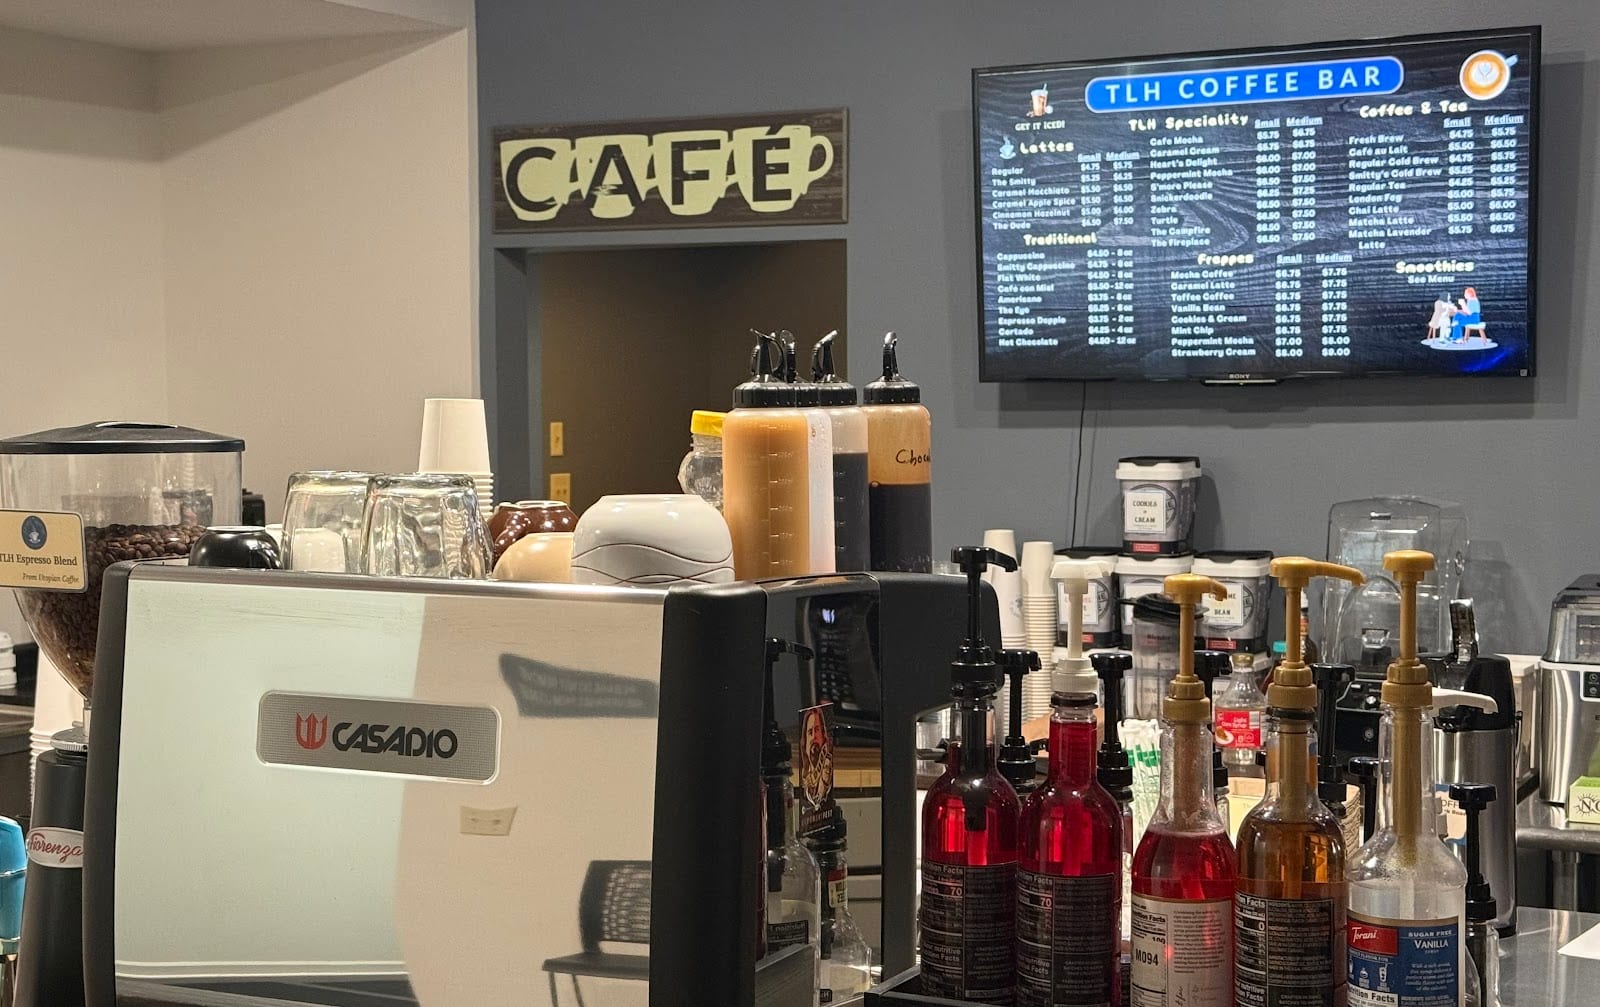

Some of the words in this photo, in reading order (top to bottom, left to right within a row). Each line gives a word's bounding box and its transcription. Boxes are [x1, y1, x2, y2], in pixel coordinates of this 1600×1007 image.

[1106, 82, 1161, 103] TLH
[1179, 73, 1298, 98] COFFEE
[1318, 67, 1379, 89] BAR
[1359, 102, 1412, 118] Coffee
[1421, 101, 1431, 114] &
[1439, 98, 1468, 113] Tea
[1129, 118, 1155, 131] TLH
[1165, 112, 1248, 131] Speciality
[1255, 118, 1279, 128] Small
[1286, 115, 1322, 126] Medium
[1443, 116, 1471, 127] Small
[1484, 113, 1523, 125] Medium
[1014, 123, 1030, 131] GET
[1033, 122, 1041, 130] IT
[1043, 121, 1065, 129] ICED!
[1150, 137, 1171, 145] Cafe
[1174, 135, 1203, 144] Mocha
[1349, 135, 1375, 144] Fresh
[1378, 133, 1403, 142] Brew
[1020, 140, 1073, 153] Lattes
[1150, 147, 1186, 157] Caramel
[1189, 146, 1219, 155] Cream
[1349, 147, 1371, 156] Café
[1389, 145, 1407, 154] Lait
[1077, 153, 1101, 163] Small
[1106, 150, 1139, 161] Medium
[1349, 158, 1385, 168] Regular
[1388, 157, 1410, 165] Cold
[1412, 155, 1439, 164] Brew
[1150, 159, 1183, 168] Heart's
[1185, 157, 1217, 167] Delight
[991, 167, 1023, 177] Regular
[1150, 170, 1201, 181] Peppermint
[1203, 168, 1232, 176] Mocha
[1349, 170, 1388, 180] Smitty's
[1391, 168, 1413, 177] Cold
[1415, 167, 1441, 176] Brew
[992, 178, 1007, 186] The
[1009, 177, 1036, 187] Smitty
[1150, 182, 1181, 191] S'more
[1183, 180, 1212, 189] Please
[1349, 182, 1385, 192] Regular
[1388, 181, 1405, 189] Tea
[992, 188, 1025, 197] Caramel
[1028, 186, 1069, 195] Macchiato
[1150, 192, 1212, 202] Snickerdoodle
[1349, 194, 1382, 203] London
[1384, 193, 1402, 202] Fog
[992, 200, 1025, 208] Caramel
[1028, 199, 1050, 207] Apple
[1053, 197, 1075, 206] Spice
[992, 211, 1032, 219] Cinnamon
[1034, 209, 1070, 217] Hazelnut
[1150, 205, 1176, 213] Zebra
[1349, 206, 1369, 215] Chai
[1372, 205, 1398, 214] Latte
[1151, 216, 1178, 224] Turtle
[1349, 217, 1384, 226] Matcha
[1387, 216, 1413, 225] Latte
[993, 222, 1008, 230] The
[1010, 221, 1030, 229] Dude
[1168, 226, 1210, 236] Campfire
[1349, 229, 1384, 238] Matcha
[1387, 227, 1431, 236] Lavender
[1023, 231, 1096, 246] Traditional
[1169, 237, 1209, 247] Fireplace
[1358, 241, 1384, 249] Latte
[997, 251, 1044, 261] Cappuccino
[1197, 251, 1253, 266] Frappes
[1276, 254, 1302, 264] Small
[1316, 253, 1352, 263] Medium
[997, 263, 1025, 272] Smitty
[1027, 261, 1075, 271] Cappuccino
[1395, 259, 1473, 274] Smoothies
[1015, 273, 1040, 281] White
[1170, 271, 1199, 279] Mocha
[1202, 269, 1233, 278] Coffee
[1407, 275, 1425, 284] See
[1428, 275, 1454, 284] Menu
[997, 284, 1018, 292] Café
[1036, 283, 1054, 291] Miel
[1170, 282, 1208, 290] Caramel
[1210, 281, 1234, 289] Latte
[998, 295, 1041, 303] Americano
[1170, 293, 1200, 301] Toffee
[1202, 292, 1234, 300] Coffee
[1014, 306, 1029, 315] Eye
[1171, 304, 1200, 312] Vanilla
[998, 317, 1035, 325] Espresso
[1037, 316, 1065, 325] Doppio
[1171, 315, 1205, 323] Cookies
[1216, 314, 1246, 322] Cream
[998, 327, 1033, 335] Cortado
[1171, 326, 1191, 334] Mint
[1193, 326, 1213, 335] Chip
[1171, 337, 1221, 347] Peppermint
[1224, 336, 1253, 344] Mocha
[1171, 348, 1223, 358] Strawberry
[16, 554, 52, 566] Espresso
[54, 556, 77, 566] Blend
[62, 575, 79, 585] Coffee
[332, 722, 458, 759] CASADIO
[950, 886, 963, 896] 70
[1041, 897, 1052, 907] 70
[1352, 927, 1378, 943] Torani
[1414, 940, 1448, 949] VANILLA
[1135, 948, 1159, 966] M094
[1371, 992, 1395, 1003] Facts
